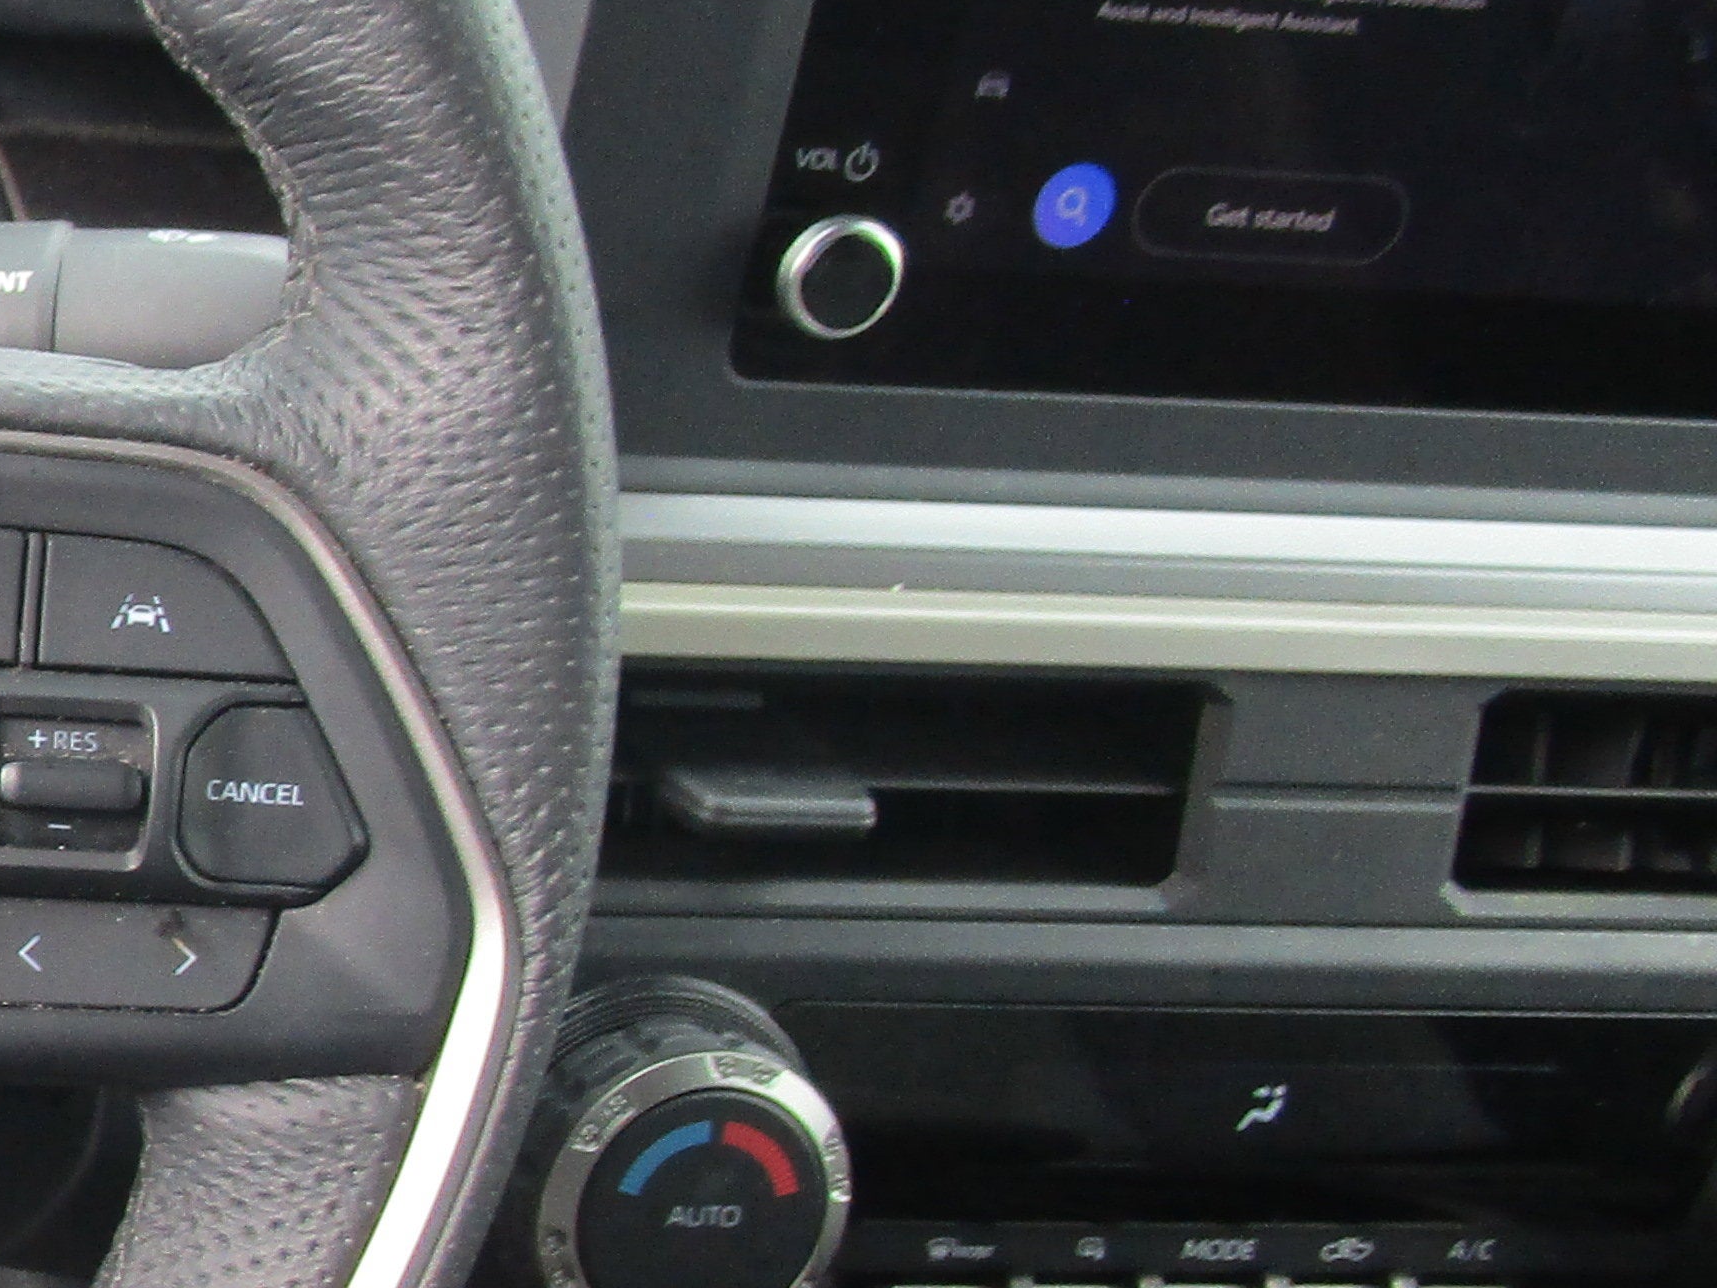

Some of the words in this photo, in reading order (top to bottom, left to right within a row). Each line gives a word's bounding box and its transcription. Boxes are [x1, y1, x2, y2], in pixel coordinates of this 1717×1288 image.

[1204, 202, 1249, 227] Get
[1254, 205, 1336, 233] started
[205, 778, 304, 808] CANCEL
[665, 1204, 743, 1228] AUTO
[1180, 1237, 1259, 1261] MODE
[1446, 1238, 1497, 1262] A/C
